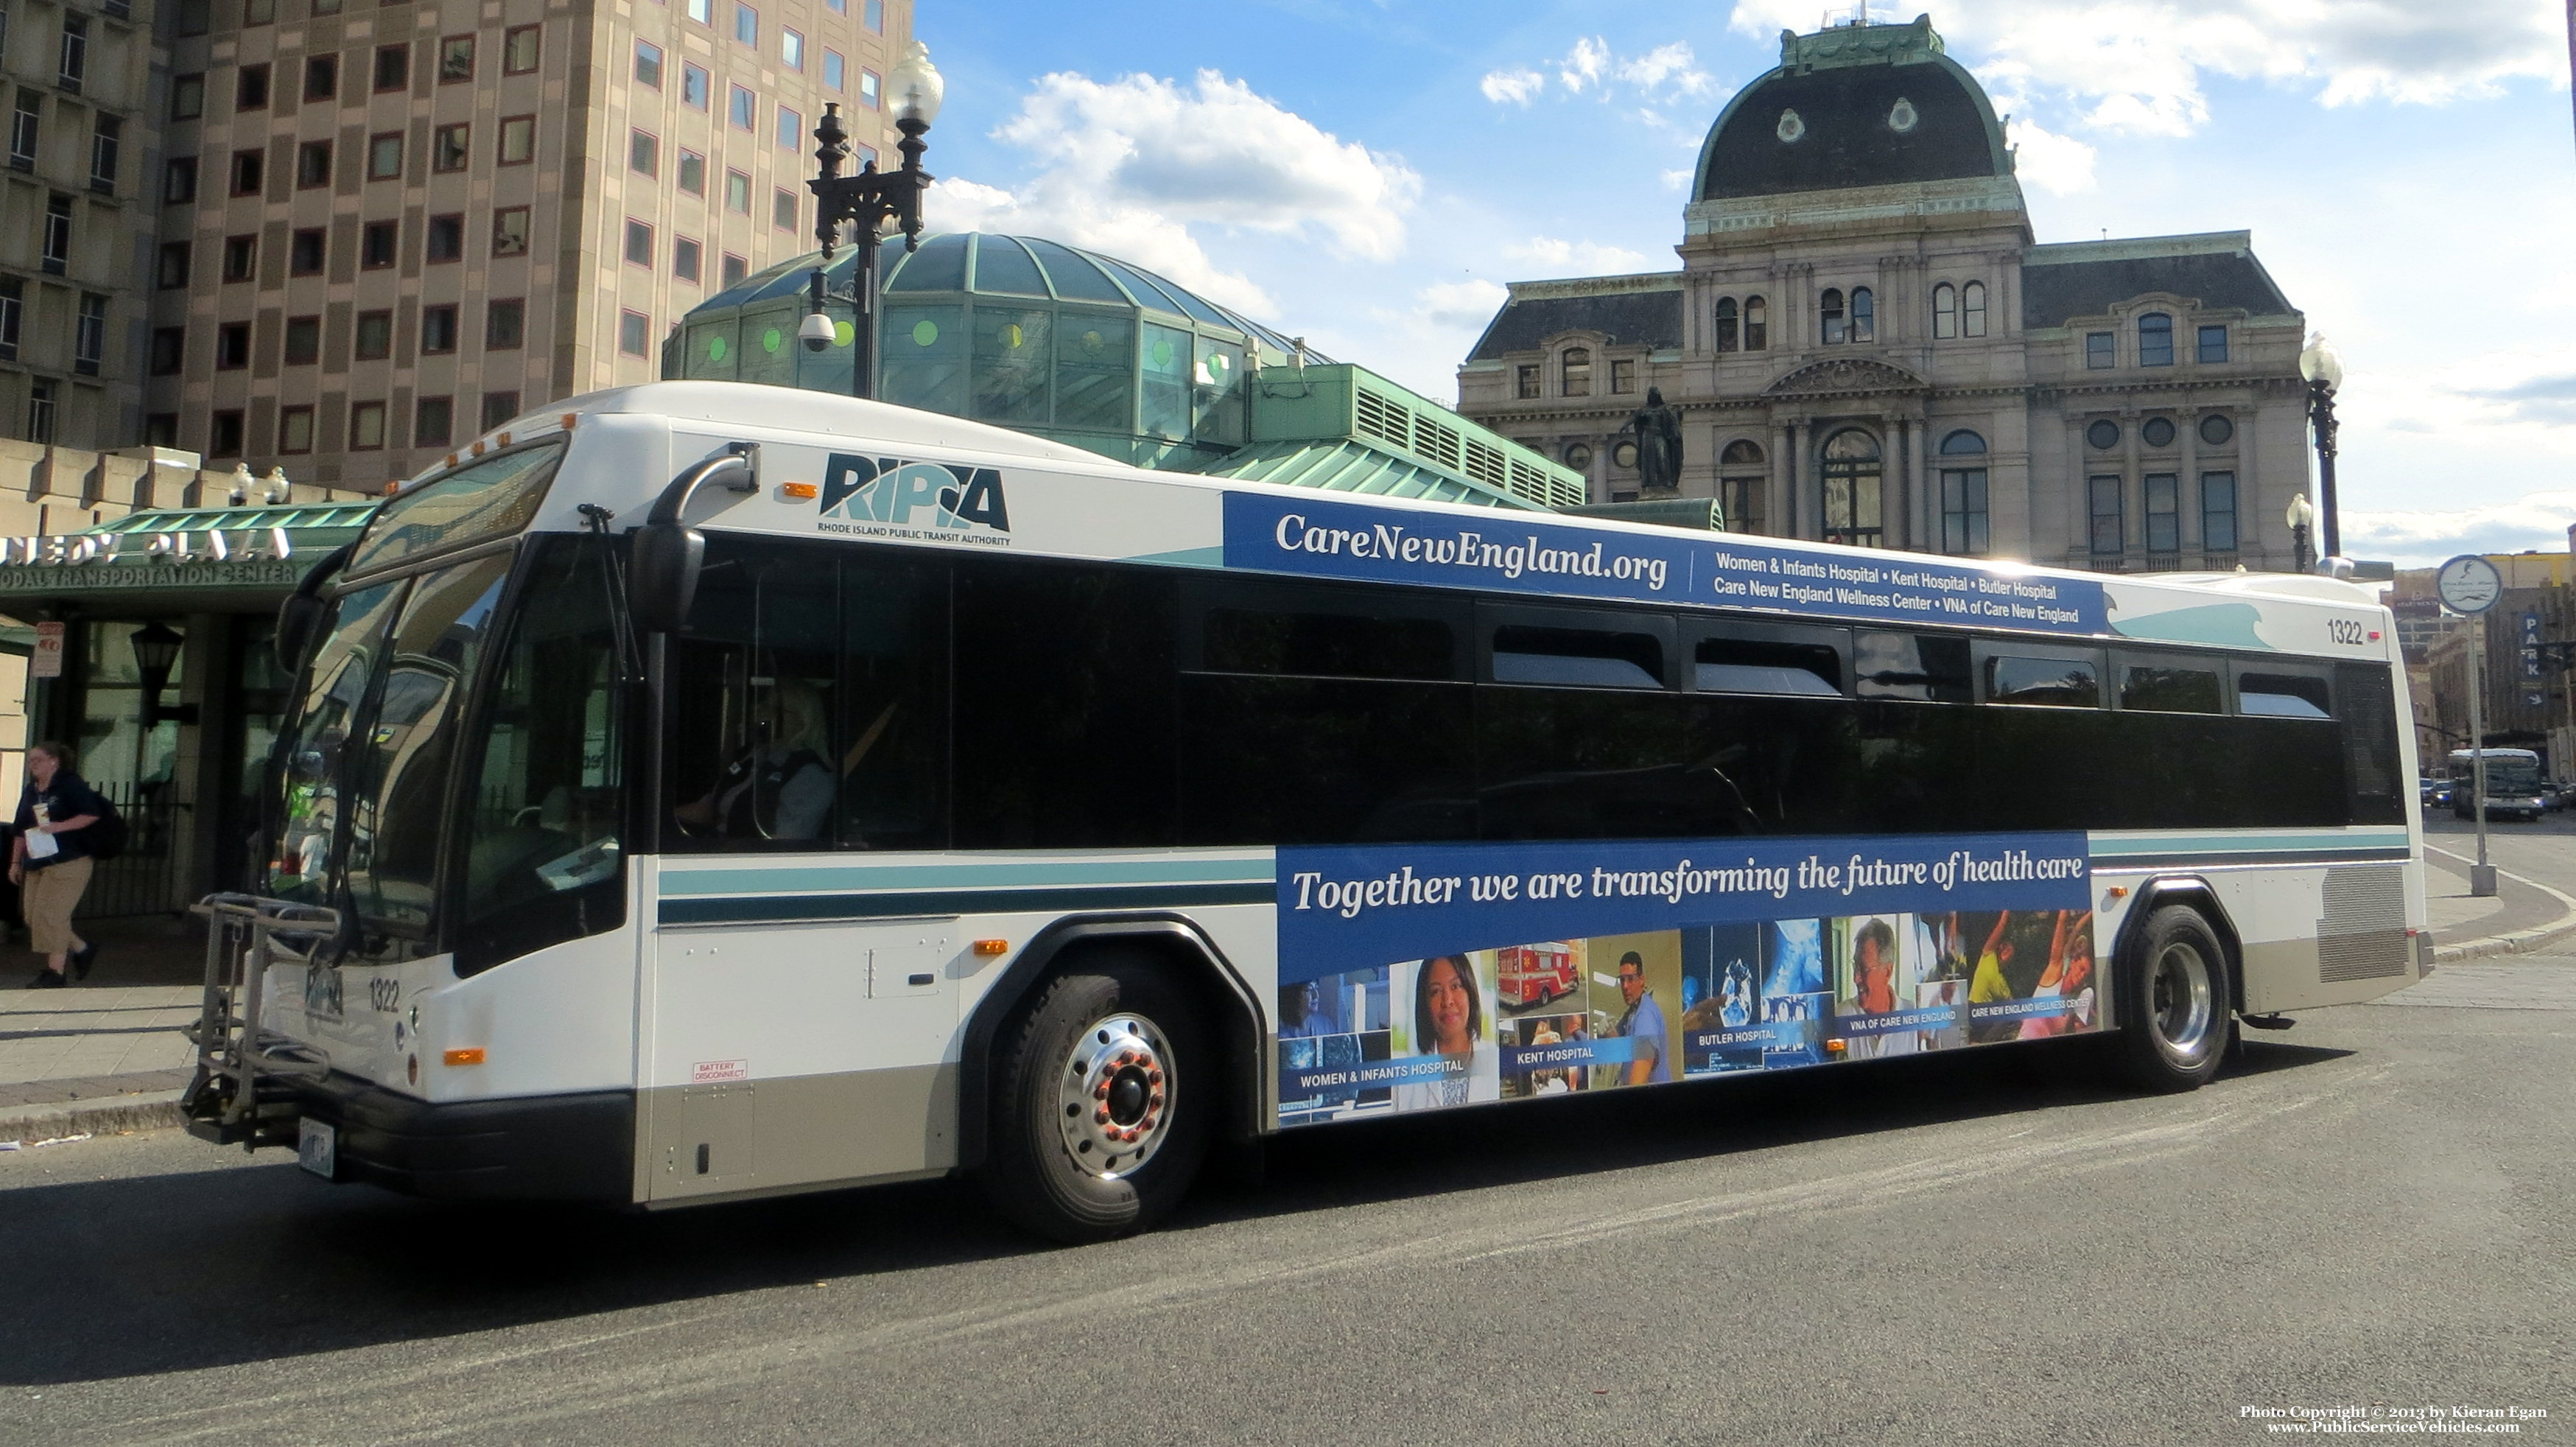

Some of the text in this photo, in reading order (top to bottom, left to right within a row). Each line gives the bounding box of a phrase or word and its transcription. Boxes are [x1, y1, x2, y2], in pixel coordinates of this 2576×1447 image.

[820, 452, 1011, 533] RIPTA
[145, 527, 292, 565] PLAZA
[818, 522, 1011, 546] RHODE ISLAND PUBLIC TRANSIT AUTHORITY
[1276, 514, 1667, 590] CareNewEngland.org
[49, 566, 213, 587] TRANSPORTATION
[222, 564, 294, 582] CENTER
[1716, 552, 2057, 600] Women & Infants Hospital Kent Hospital Butler Hospital
[1714, 577, 2079, 624] Care New England Wellness Center VNA of Care New England
[2328, 619, 2363, 645] 1322
[1293, 866, 1461, 917] Together
[1470, 874, 1519, 901] we
[1528, 872, 1583, 899] are
[1592, 858, 1789, 905] transforming
[1798, 855, 1840, 889] the
[1842, 854, 1927, 896] future
[1933, 851, 1960, 891] of
[371, 978, 399, 1013] 1322
[1850, 1011, 1956, 1031] VNA OF CARE NEW ENGLAND
[1971, 1008, 1989, 1017] CARE
[1990, 1006, 2004, 1016] NEW
[2005, 1003, 2033, 1015] ENGLAND
[2035, 1001, 2066, 1012] WELLNESS
[1699, 1029, 1777, 1045] BUTLER HOSPITAL
[700, 1062, 734, 1071] BATTERY
[1517, 1047, 1594, 1064] KENT HOSPITAL
[695, 1070, 744, 1080] DISCONNECT
[1301, 1059, 1464, 1087] WOMEN & INFANTS HOSPITAL
